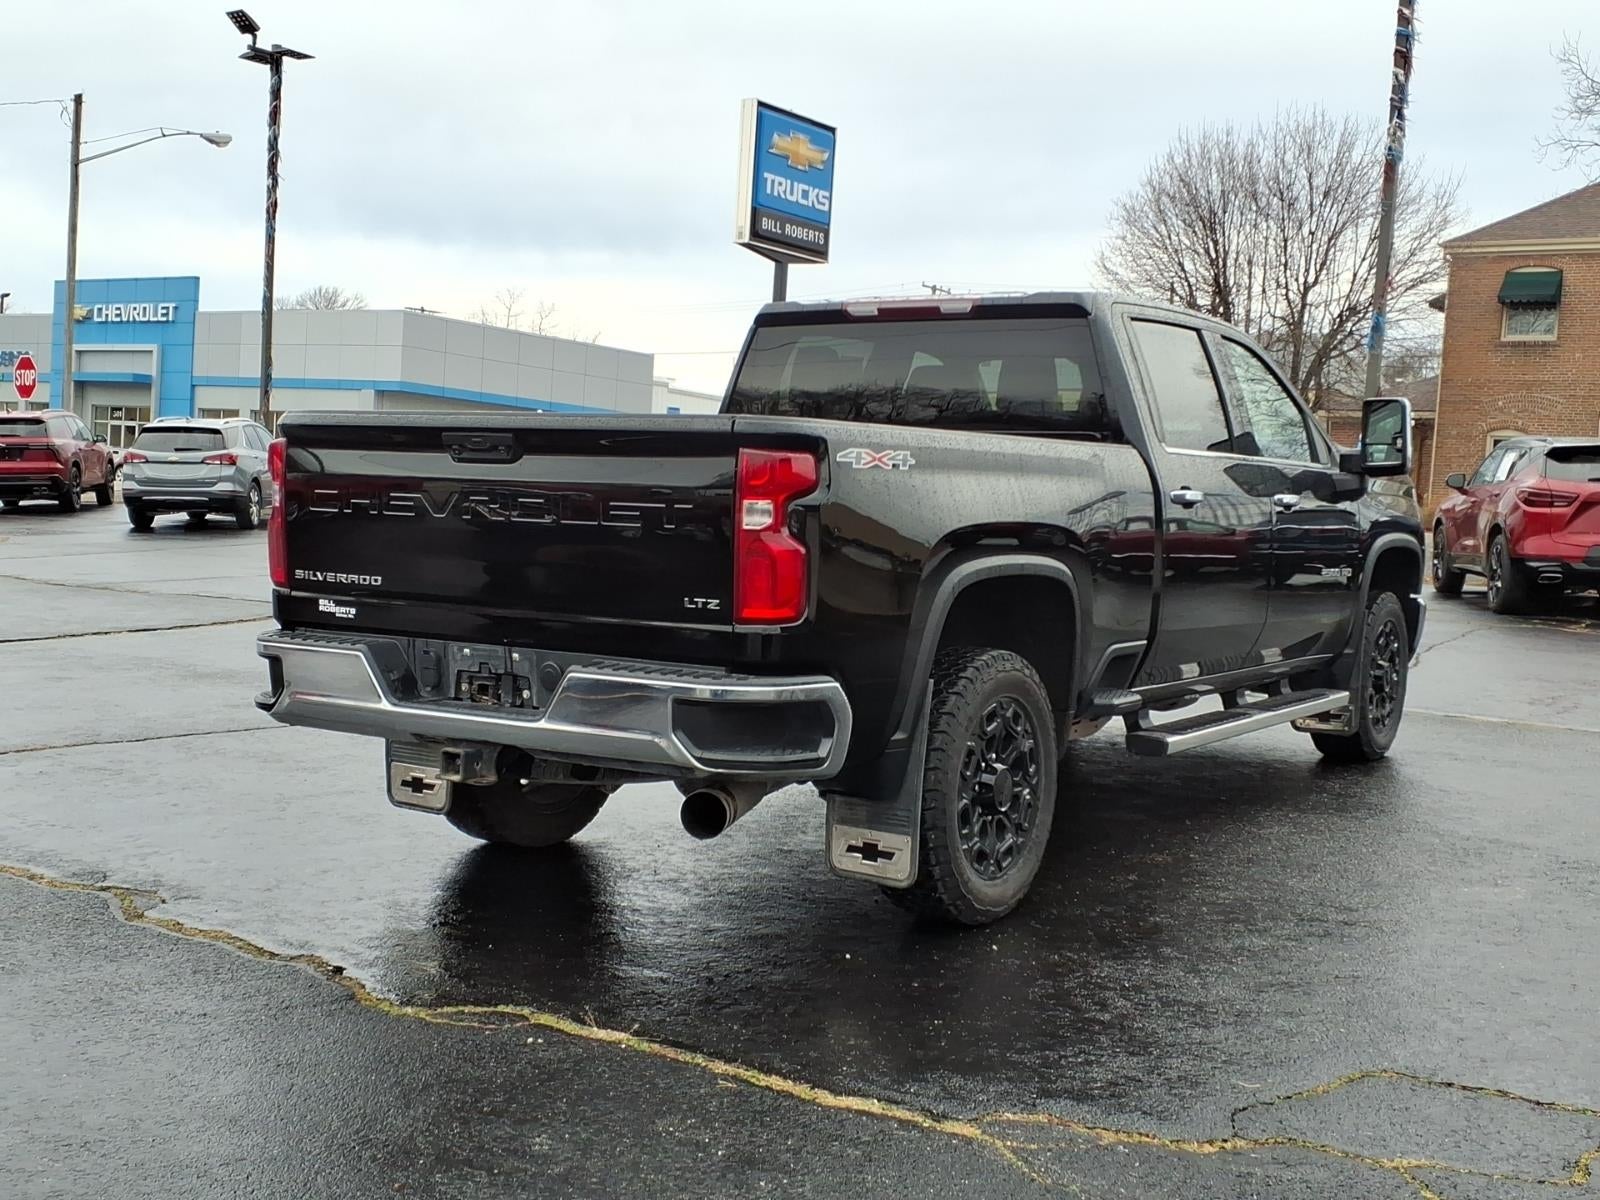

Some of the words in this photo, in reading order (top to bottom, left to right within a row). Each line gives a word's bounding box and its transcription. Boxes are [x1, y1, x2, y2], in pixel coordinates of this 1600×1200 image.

[764, 173, 830, 211] TRUCKS
[762, 218, 782, 233] BILL
[785, 224, 824, 244] ROBERTS
[94, 303, 178, 322] CHEVROLET
[16, 370, 35, 386] STOP
[309, 489, 694, 529] CHEVROLET
[295, 570, 382, 585] SILVERADO
[319, 606, 356, 614] ROBERTS
[684, 597, 720, 610] LTZ
